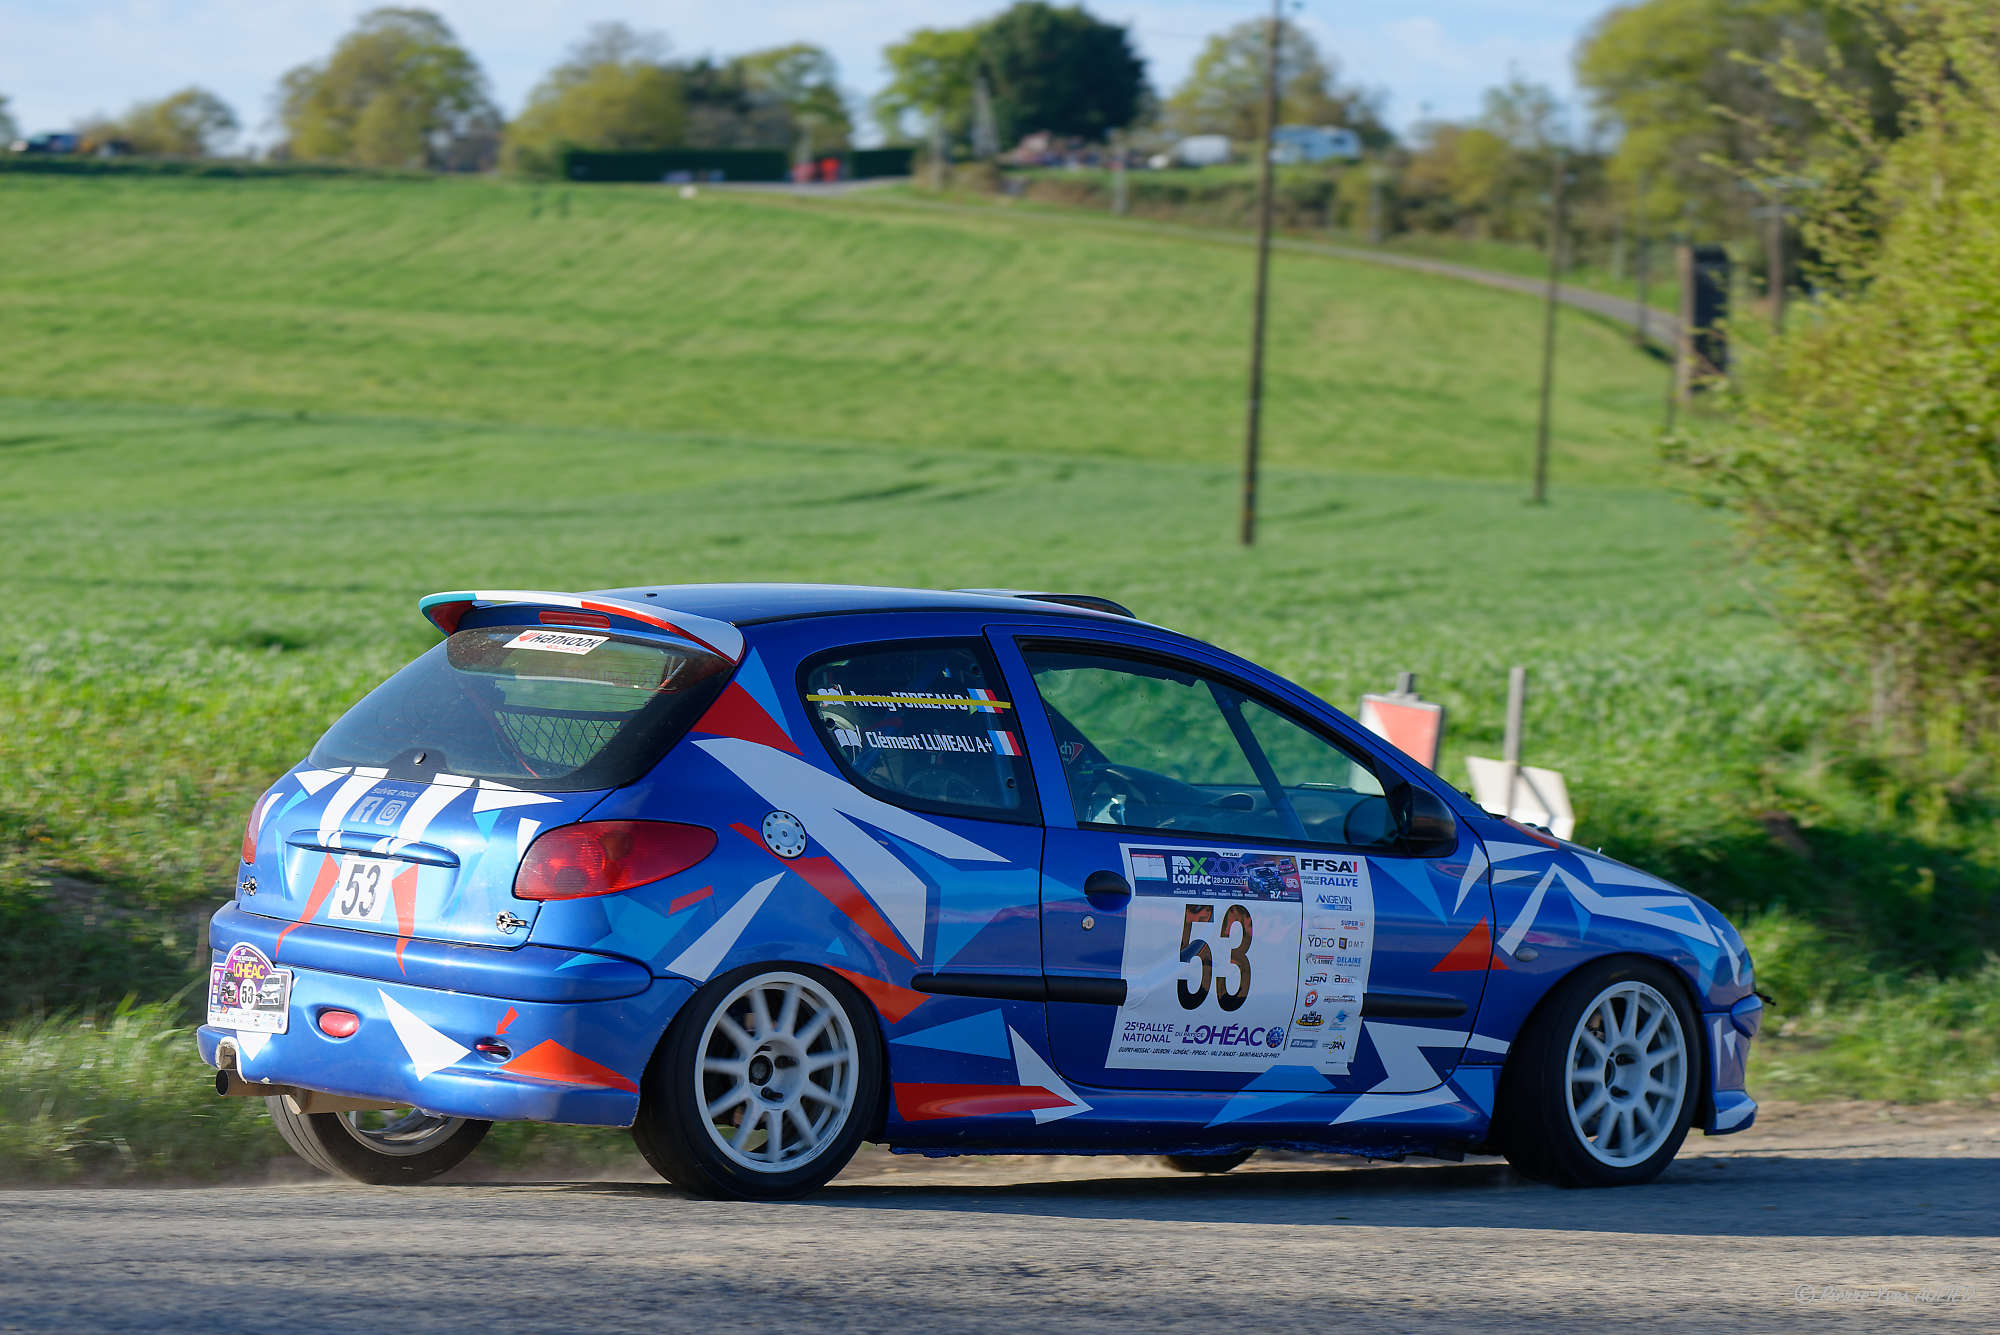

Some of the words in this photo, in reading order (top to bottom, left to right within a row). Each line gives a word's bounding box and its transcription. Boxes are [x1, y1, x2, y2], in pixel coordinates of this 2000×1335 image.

[865, 731, 923, 750] Clément
[920, 733, 975, 752] LUMEAU
[975, 736, 992, 753] A+
[1173, 875, 1212, 885] LOHEAC
[1320, 876, 1358, 888] RALLYE
[341, 864, 380, 917] 53
[1315, 894, 1352, 904] ANGEVIN
[1177, 904, 1253, 1012] 53
[241, 984, 255, 1005] 53
[1139, 1022, 1174, 1032] RALLYE
[1182, 1023, 1266, 1046] LOHÉAC
[1122, 1032, 1171, 1043] NATIONAL
